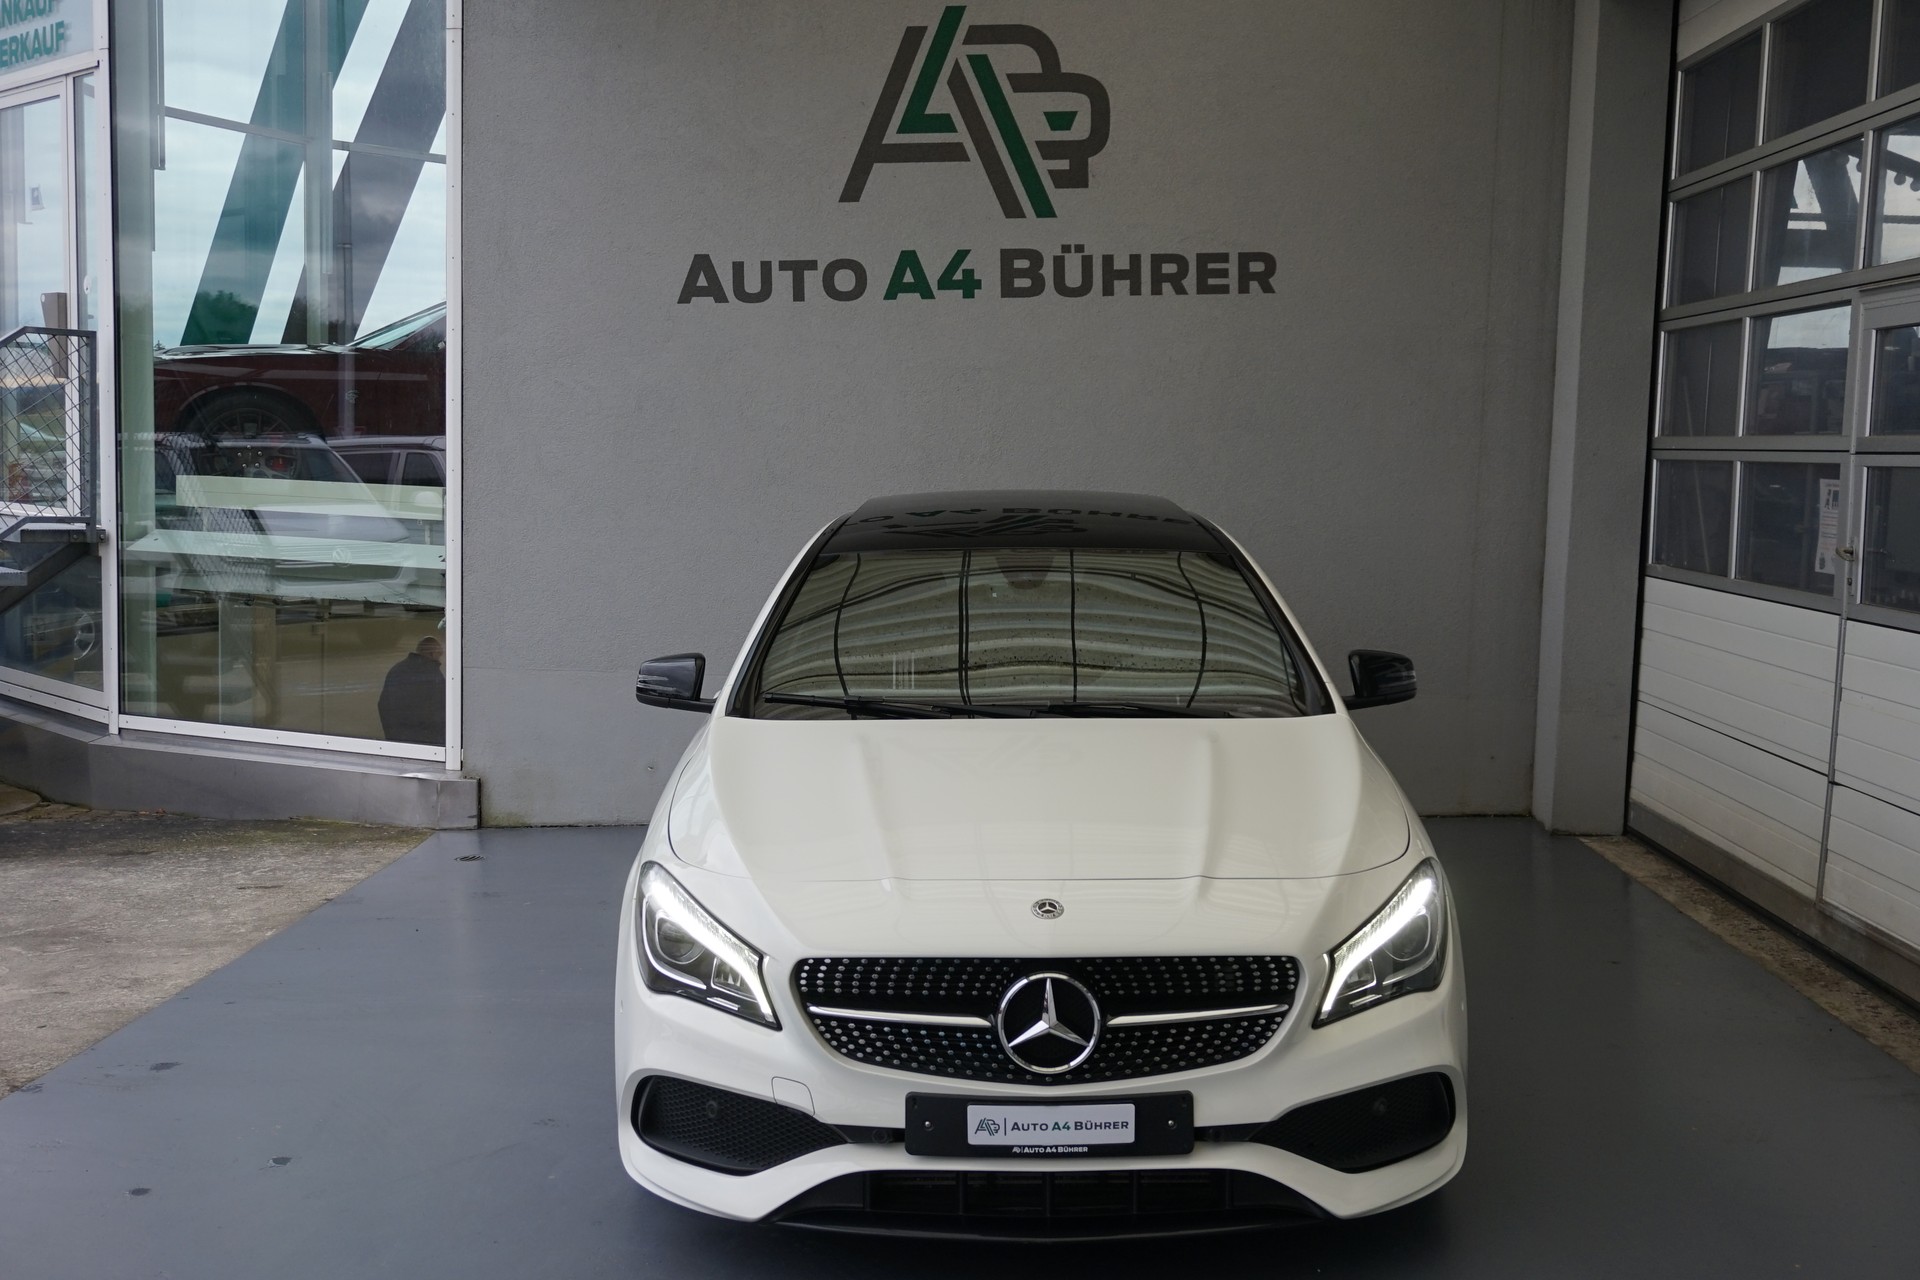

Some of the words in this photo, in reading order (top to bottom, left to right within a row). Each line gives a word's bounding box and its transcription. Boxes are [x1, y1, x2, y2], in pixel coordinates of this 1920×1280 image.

[677, 253, 868, 304] AUTO
[883, 249, 982, 300] A4
[1000, 244, 1277, 299] BÜHRER
[1011, 1121, 1048, 1131] AUTO
[1052, 1121, 1071, 1131] A4
[1074, 1120, 1129, 1130] BÜHRER
